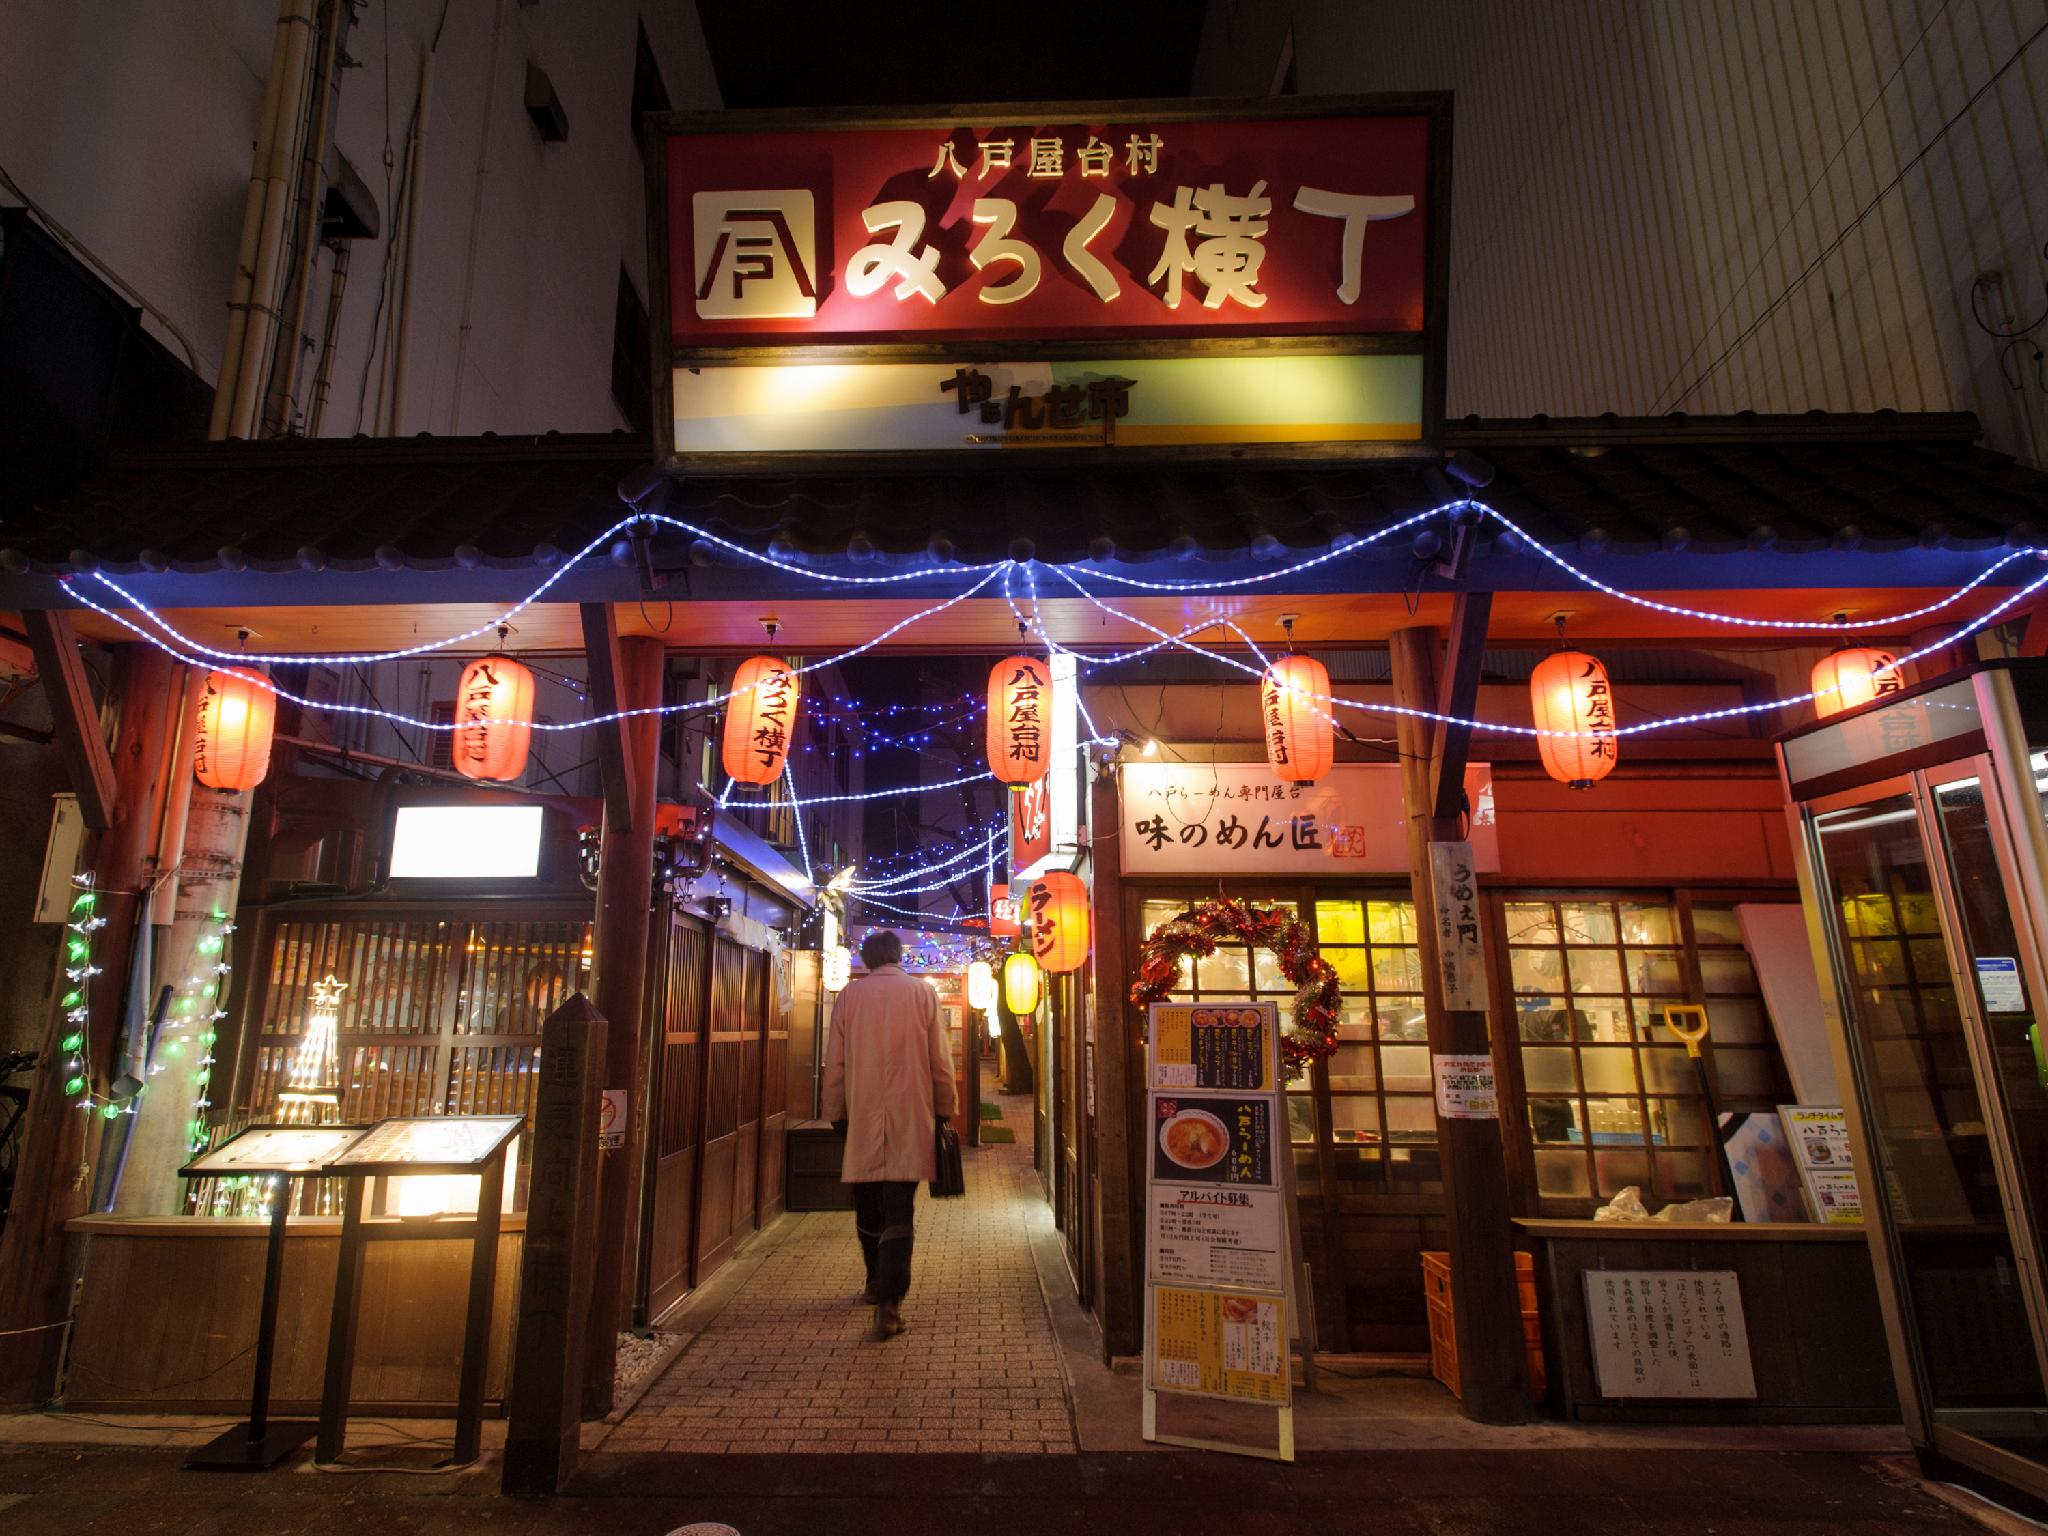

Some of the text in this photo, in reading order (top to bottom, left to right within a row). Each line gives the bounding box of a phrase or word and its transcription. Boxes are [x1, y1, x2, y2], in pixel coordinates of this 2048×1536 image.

[928, 132, 1166, 179] 八戸屋台村
[843, 179, 1416, 311] みろく横丁
[754, 669, 792, 768] みろく横丁
[1008, 665, 1045, 762] 八戸屋台村
[1146, 784, 1305, 802] 八戸らーめん専門屋台
[1135, 814, 1323, 852] 味のめん匠
[1031, 883, 1056, 958] ラーメン
[1237, 1104, 1252, 1179] 八戸らーめん
[1179, 1190, 1249, 1205] アルバイト募集
